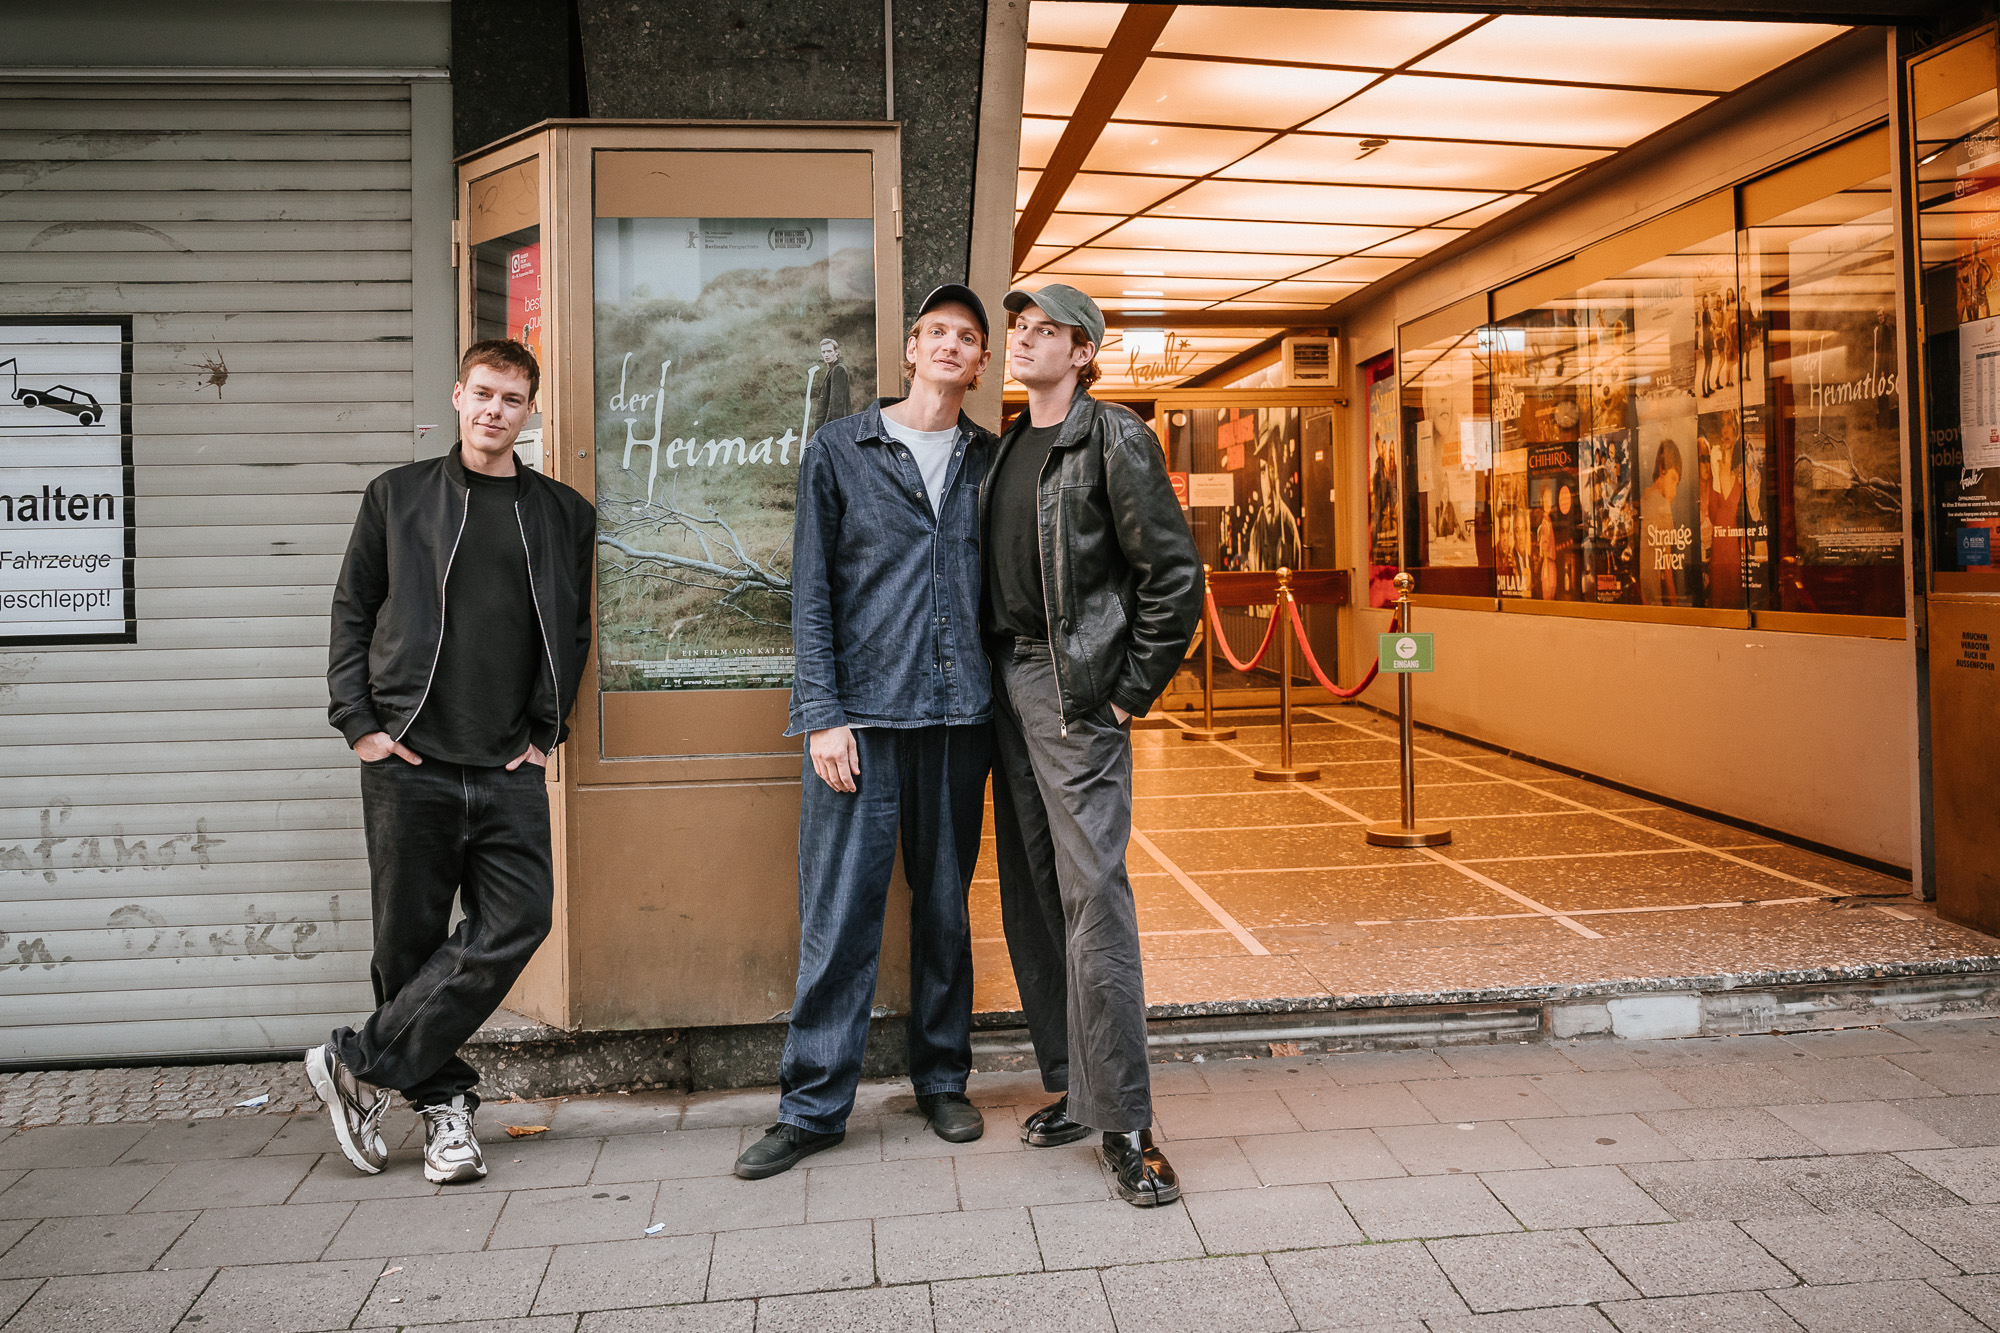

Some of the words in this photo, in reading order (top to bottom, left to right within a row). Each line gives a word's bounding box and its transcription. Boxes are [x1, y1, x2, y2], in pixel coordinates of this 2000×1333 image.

[609, 351, 654, 412] der
[1647, 524, 1692, 550] Strange
[1713, 526, 1726, 537] Für
[1758, 525, 1768, 537] 16
[1, 551, 111, 573] Fahrzeuge
[1654, 547, 1685, 570] River
[0, 589, 111, 612] eschleppt!
[1962, 631, 1988, 641] RAUCHEN
[732, 648, 753, 656] VON
[1961, 641, 1990, 651] VERBOTEN
[1393, 660, 1419, 669] EINGANG
